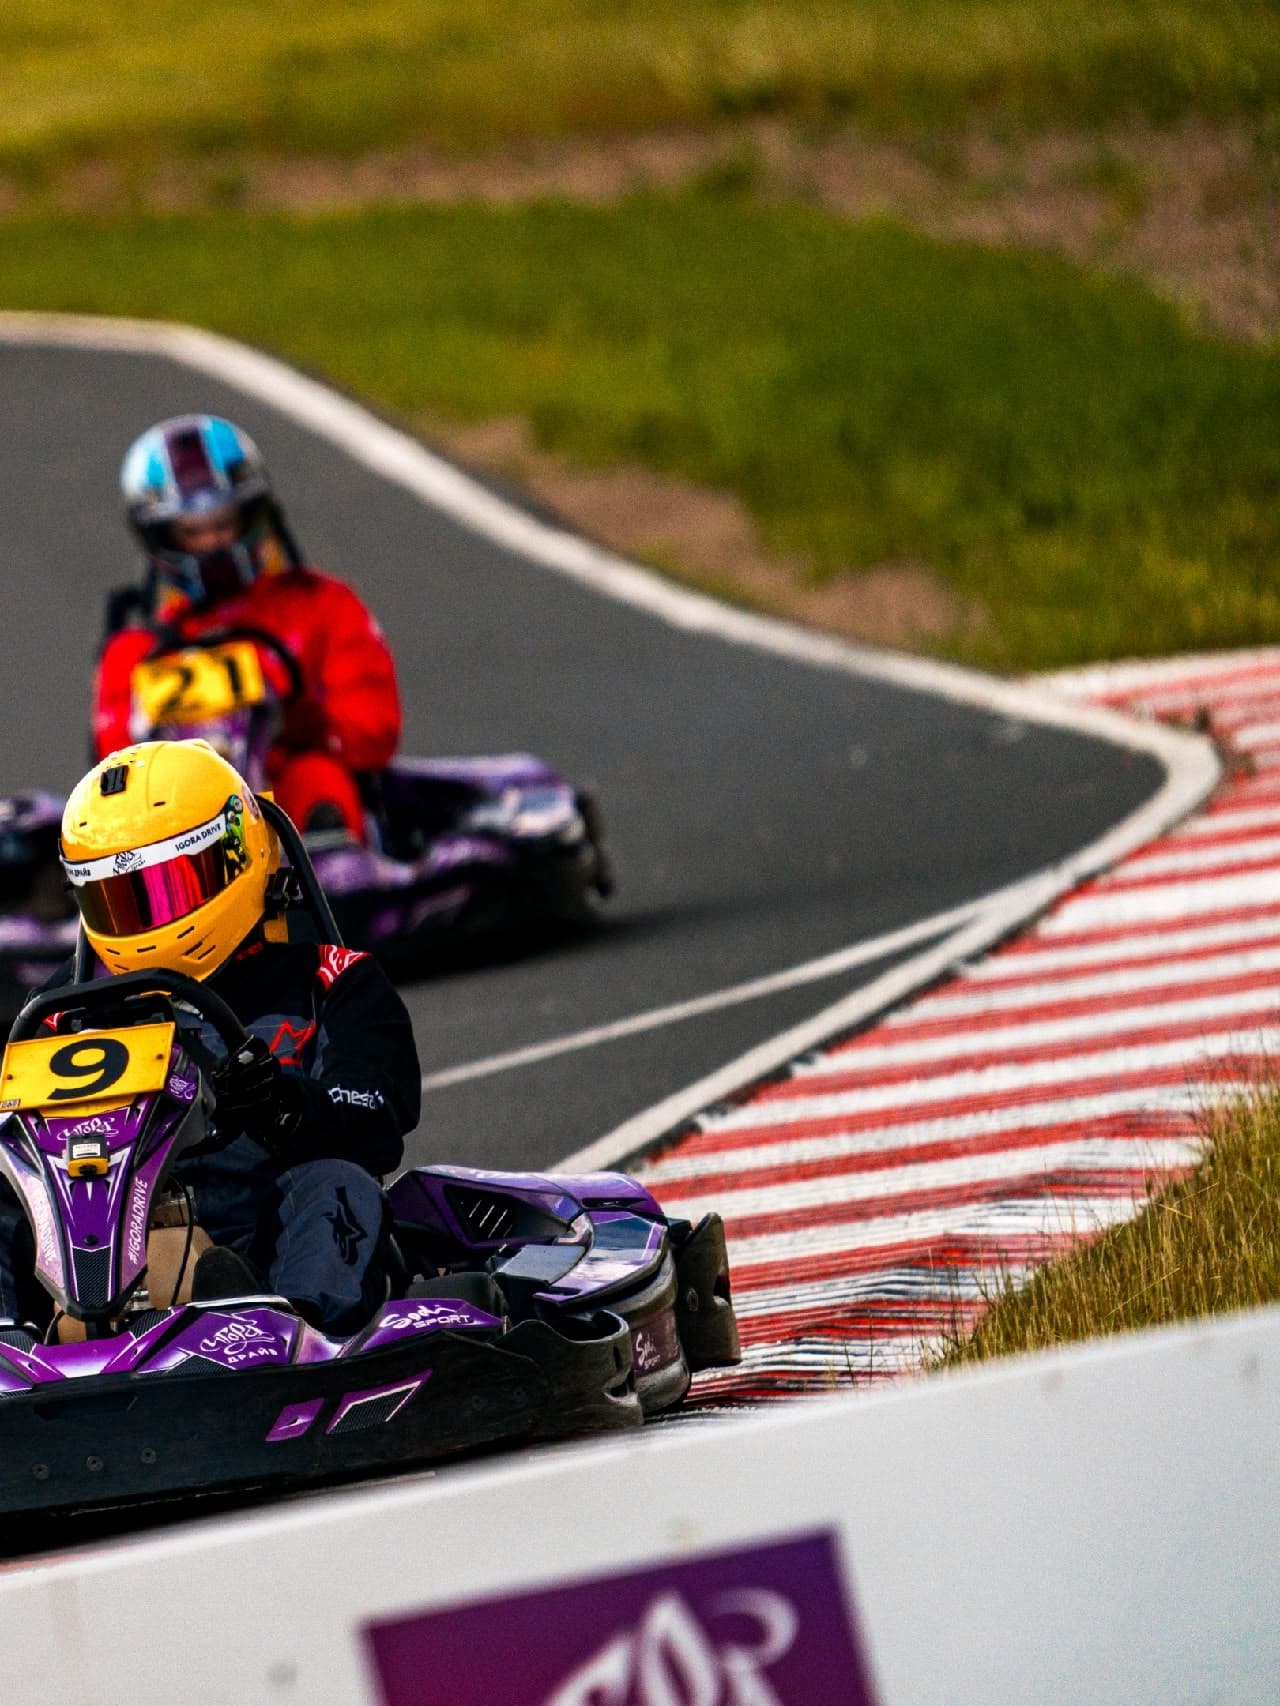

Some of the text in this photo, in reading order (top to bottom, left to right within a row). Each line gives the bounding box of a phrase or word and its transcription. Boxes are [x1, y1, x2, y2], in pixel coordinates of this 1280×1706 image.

[175, 823, 222, 852] IGORA DRIVE
[46, 1037, 130, 1101] 9
[126, 1176, 149, 1266] #IGORADRIVE
[412, 1314, 471, 1330] SPORT
